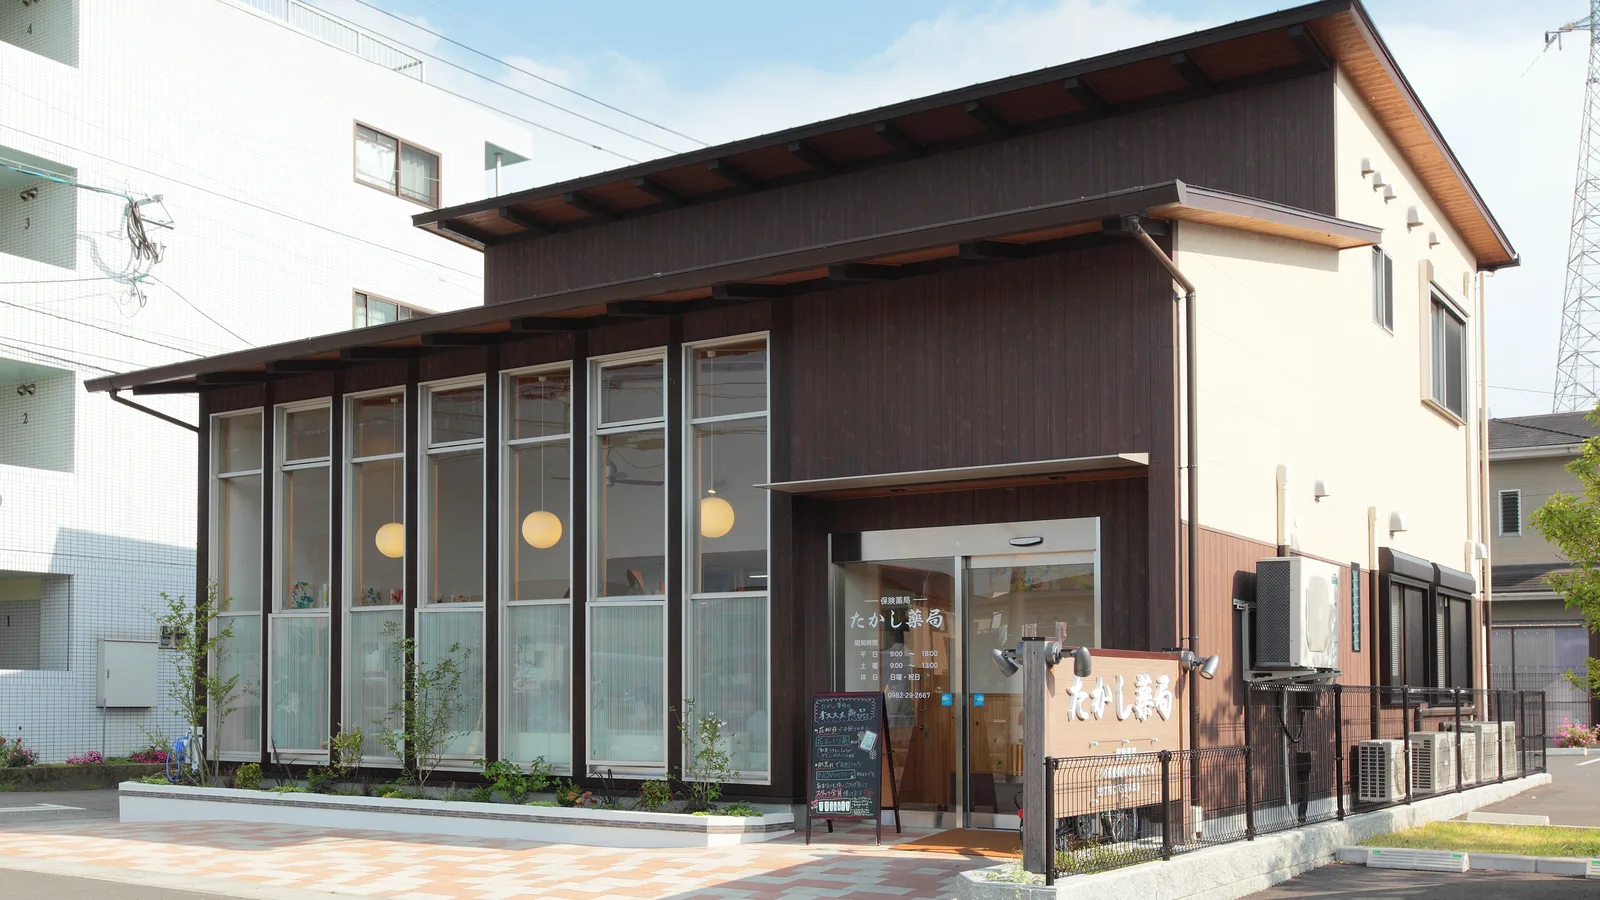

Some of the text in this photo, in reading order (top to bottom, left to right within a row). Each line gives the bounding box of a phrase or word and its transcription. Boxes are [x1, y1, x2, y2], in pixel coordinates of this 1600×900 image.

[27, 23, 33, 35] 4
[24, 217, 30, 230] 3
[22, 412, 28, 424] 2
[880, 596, 911, 605] 保険薬局
[6, 615, 10, 627] 1
[850, 608, 944, 629] たかし薬局
[854, 639, 879, 647] 開局時間
[1066, 673, 1173, 722] たかし薬局
